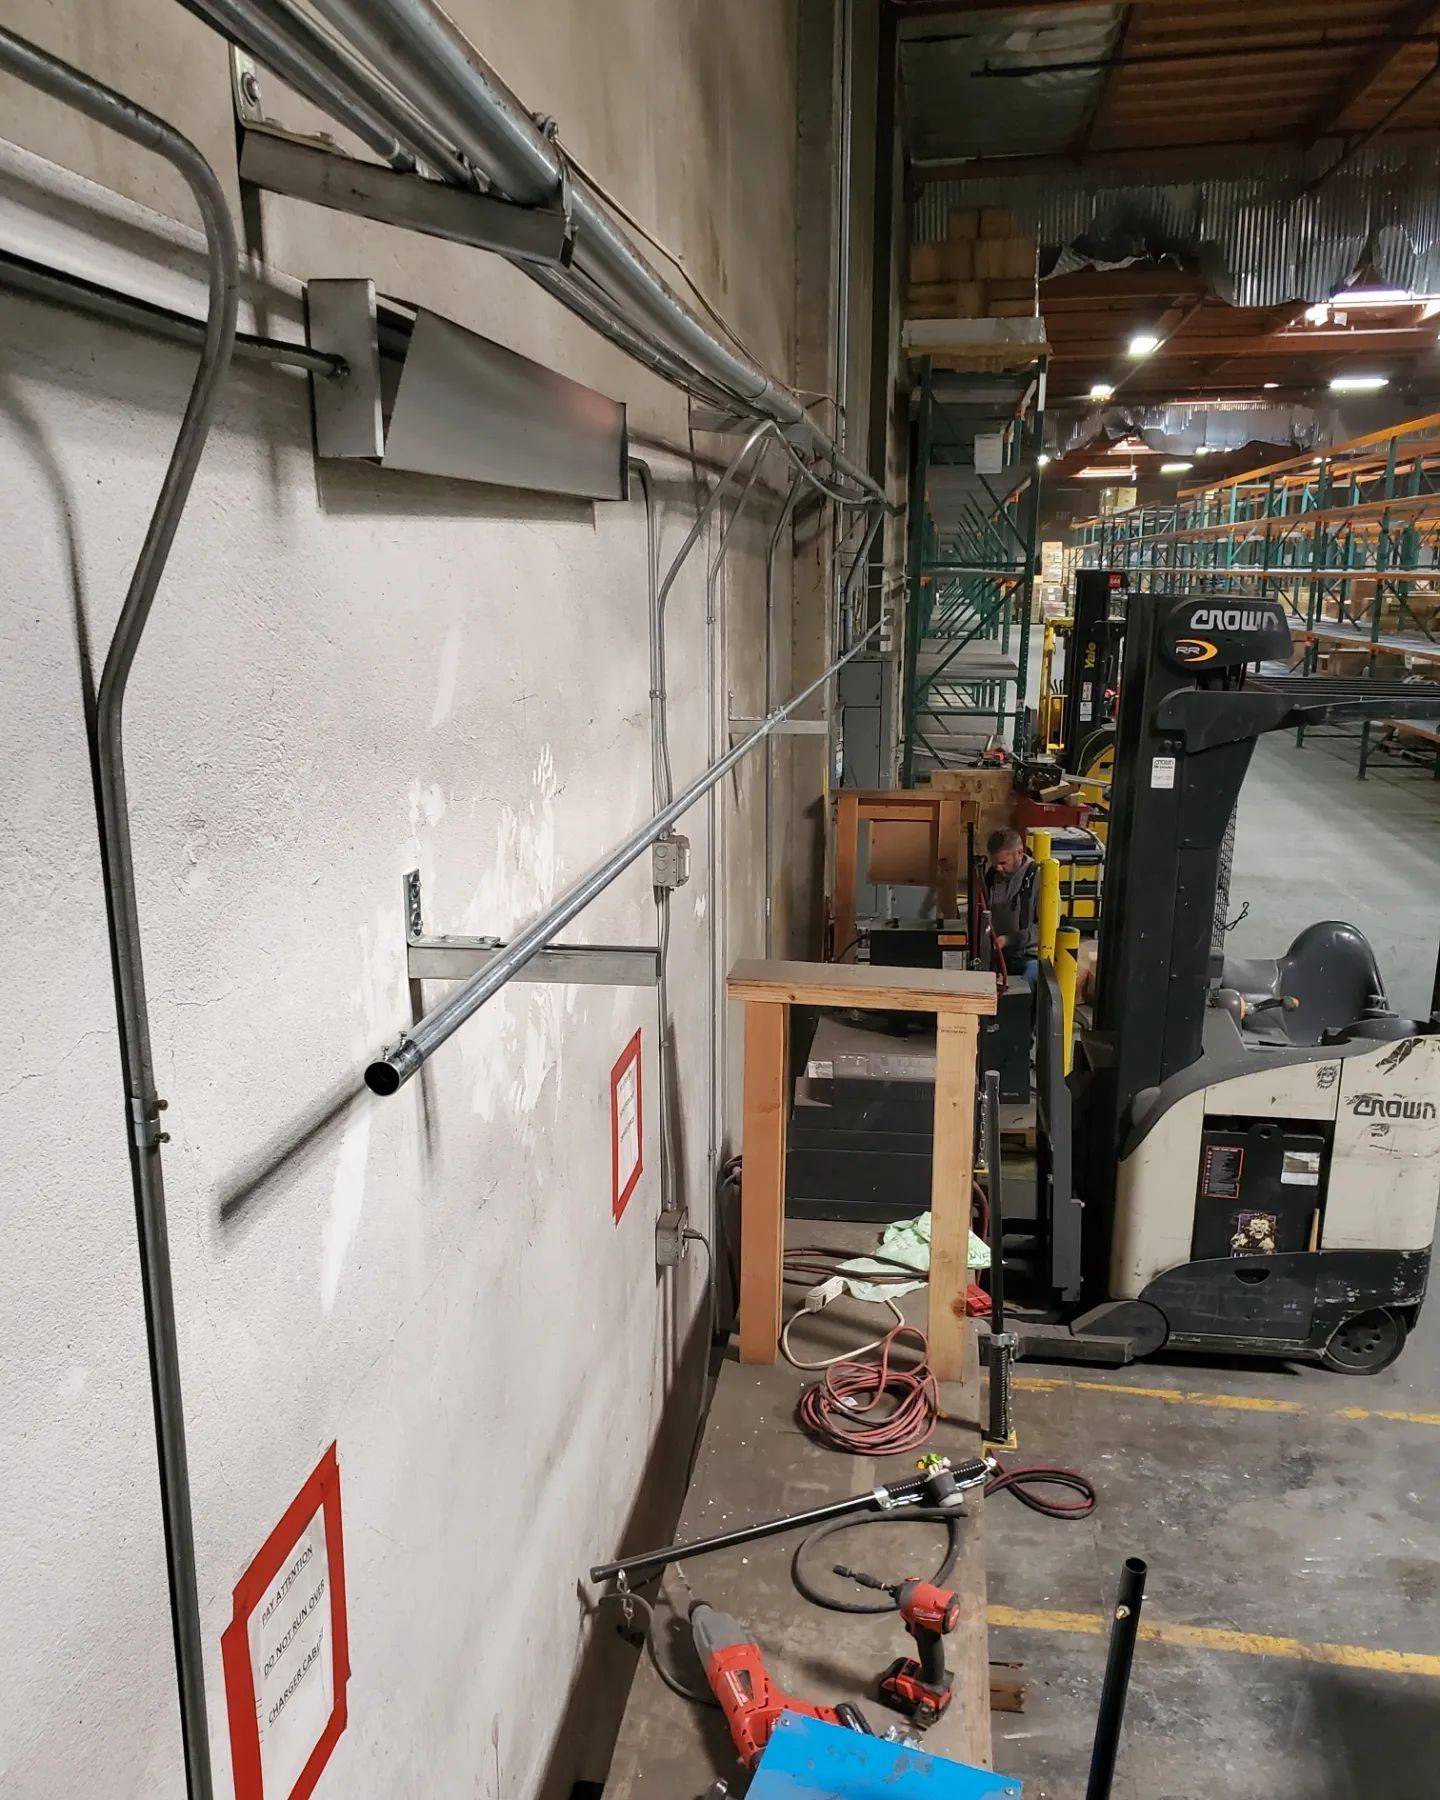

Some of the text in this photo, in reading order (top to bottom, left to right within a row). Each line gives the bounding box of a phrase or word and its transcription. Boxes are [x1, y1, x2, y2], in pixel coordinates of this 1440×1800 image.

[1189, 609, 1280, 631] CROWN
[1084, 642, 1096, 669] Yale
[1175, 646, 1200, 655] RR
[1353, 1097, 1436, 1119] CROWN
[262, 1544, 313, 1627] PAY ATTENTION
[264, 1579, 325, 1677] DO NOT RUN OVER
[268, 1668, 302, 1724] CHARGER
